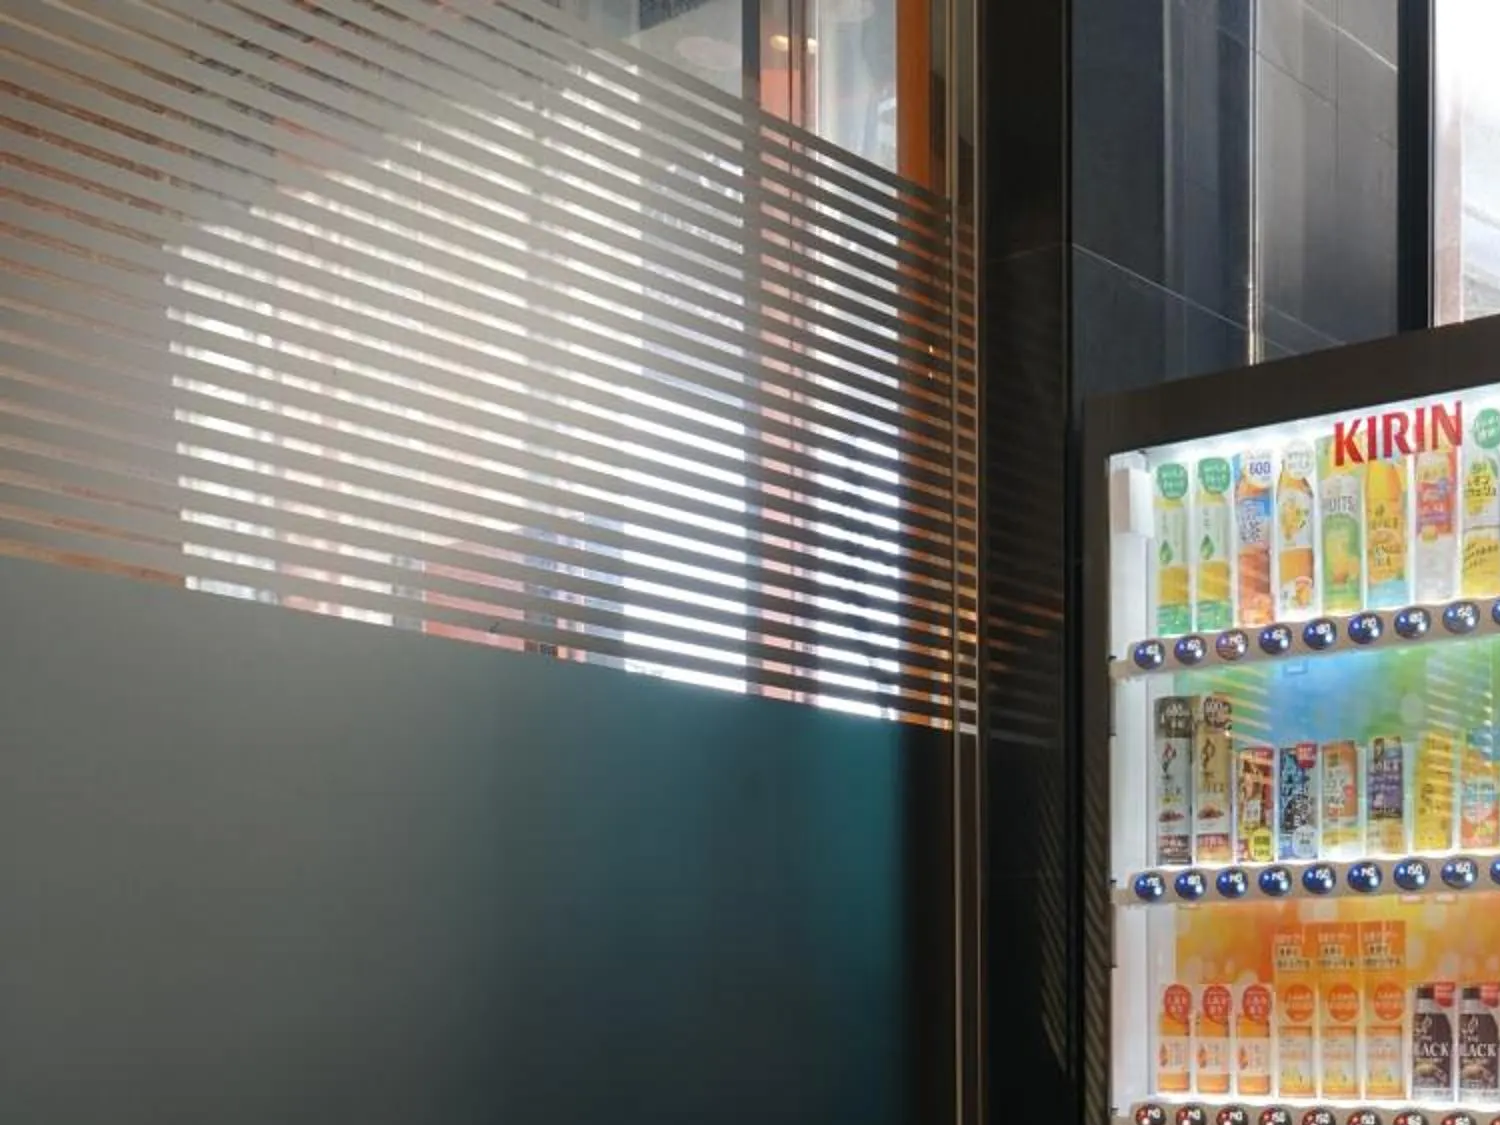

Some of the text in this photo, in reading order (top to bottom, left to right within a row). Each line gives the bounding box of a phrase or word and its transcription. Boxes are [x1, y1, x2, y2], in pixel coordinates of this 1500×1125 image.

[1334, 401, 1463, 467] KIRIN
[1249, 461, 1271, 475] 600
[1413, 1042, 1449, 1056] LACK
[1458, 1042, 1497, 1056] LACK
